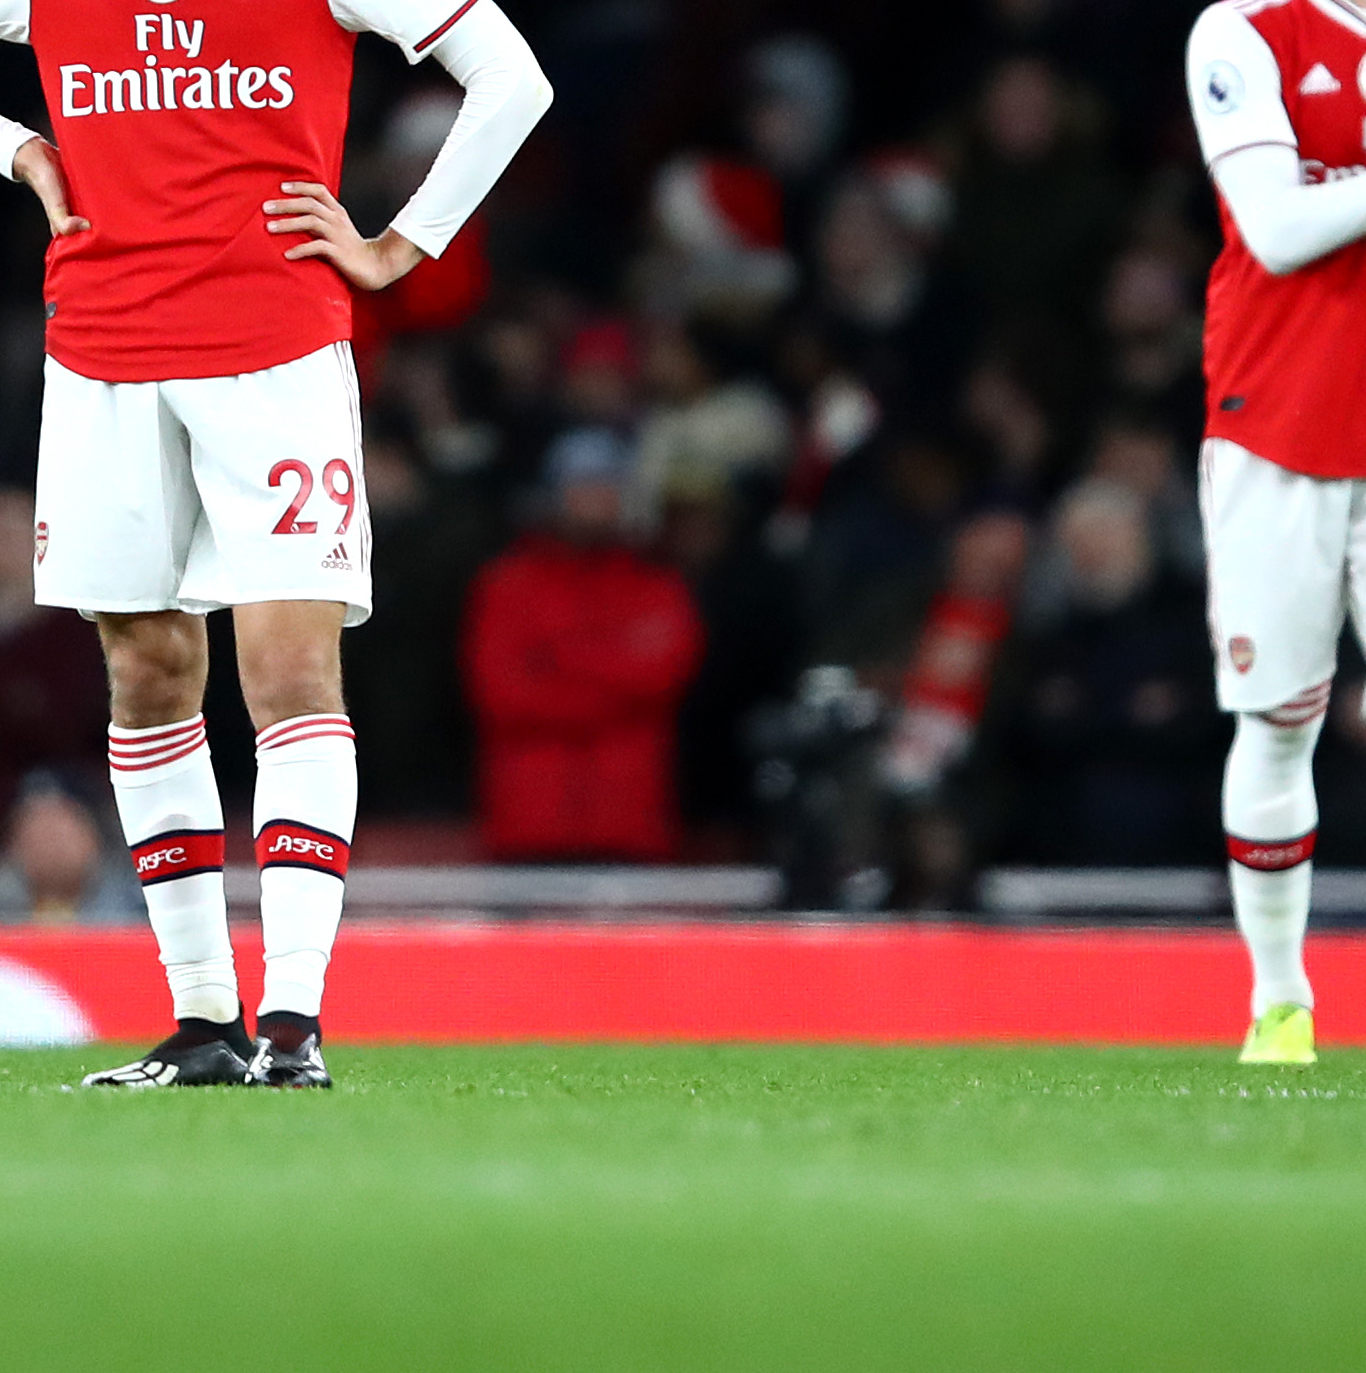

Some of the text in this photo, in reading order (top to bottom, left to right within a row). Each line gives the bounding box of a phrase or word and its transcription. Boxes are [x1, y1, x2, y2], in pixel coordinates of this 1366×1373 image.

[134, 13, 205, 58] Fly
[59, 54, 295, 118] Emirates
[268, 458, 356, 535] 29
[321, 559, 353, 571] adidas
